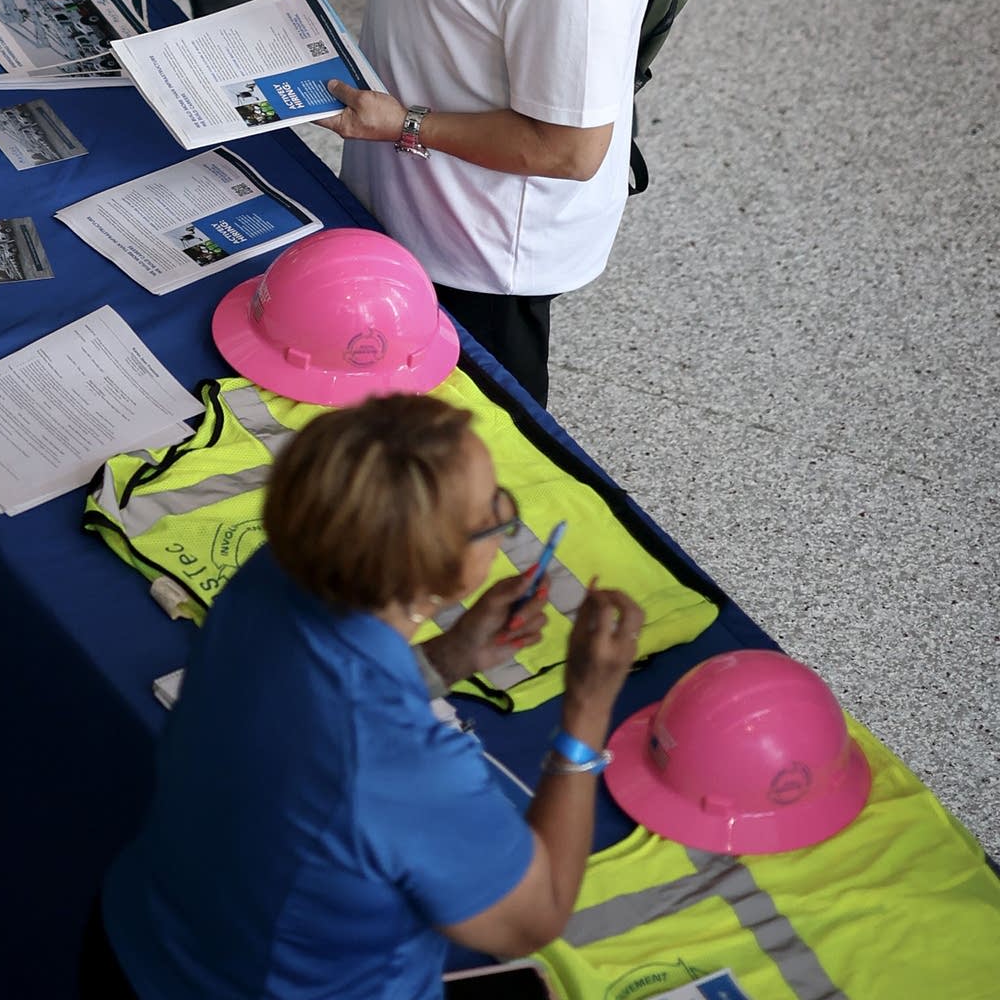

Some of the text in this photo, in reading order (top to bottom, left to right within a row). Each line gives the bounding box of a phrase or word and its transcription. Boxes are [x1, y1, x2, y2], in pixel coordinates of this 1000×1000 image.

[273, 84, 297, 110] ACTIVELY
[280, 81, 305, 108] HIRING:
[211, 222, 240, 244] ACTIVELY
[218, 219, 248, 242] HIRING:
